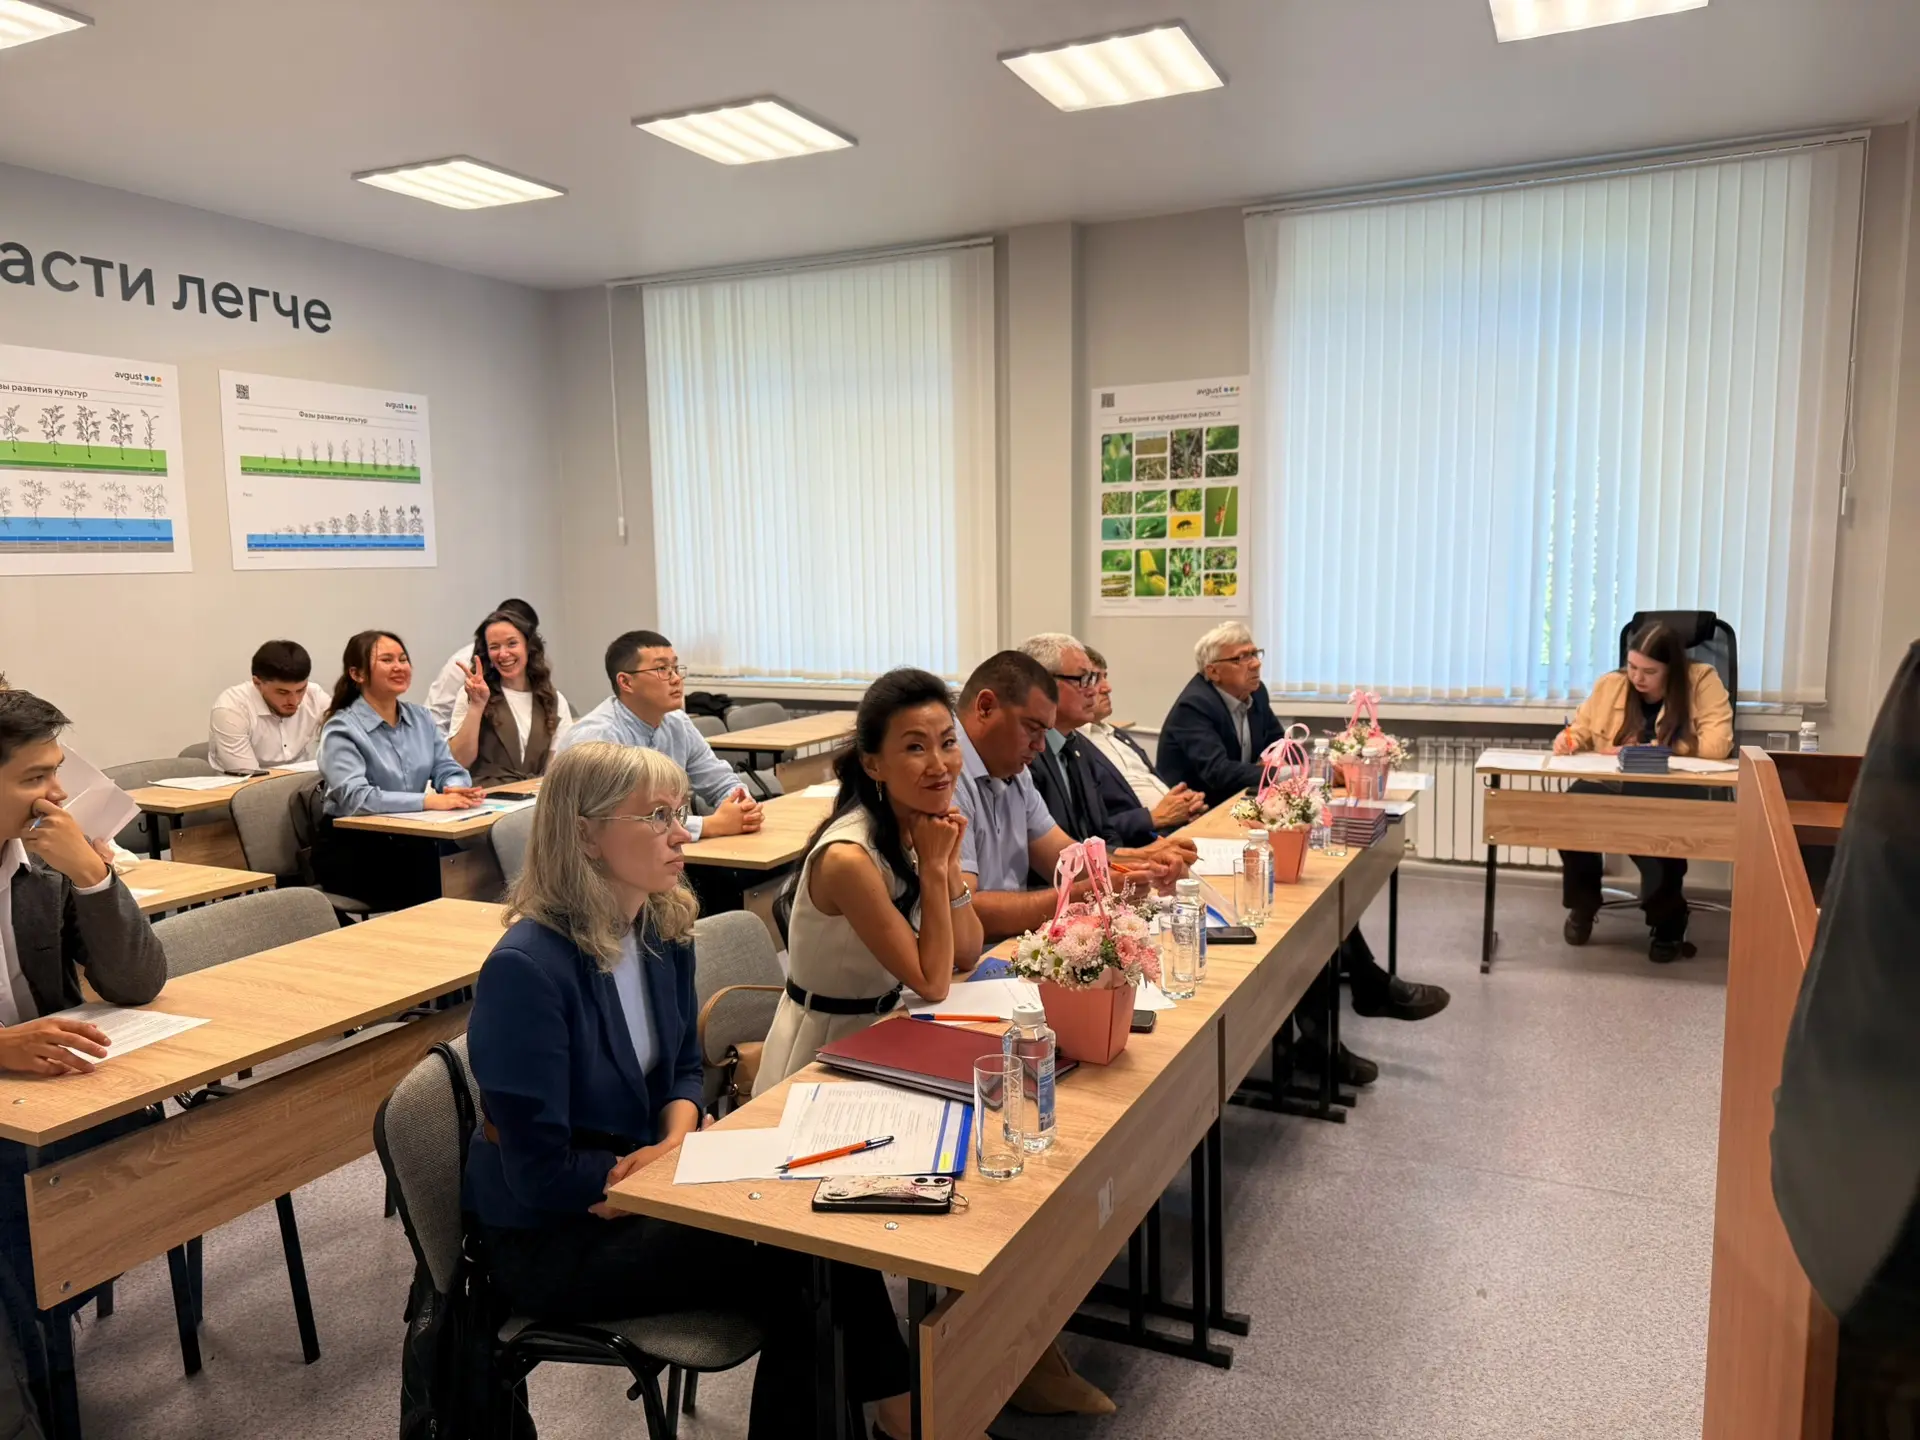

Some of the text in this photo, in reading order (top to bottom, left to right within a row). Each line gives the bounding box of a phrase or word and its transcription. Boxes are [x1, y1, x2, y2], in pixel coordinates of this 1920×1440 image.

[0, 241, 332, 333] асти легче
[114, 371, 143, 381] avgust
[11, 384, 53, 394] развития
[54, 389, 88, 398] культур
[1196, 386, 1222, 396] avgust
[385, 402, 404, 410] avgust
[316, 413, 344, 421] развития
[1157, 412, 1197, 422] вредители
[1198, 410, 1221, 418] рапса
